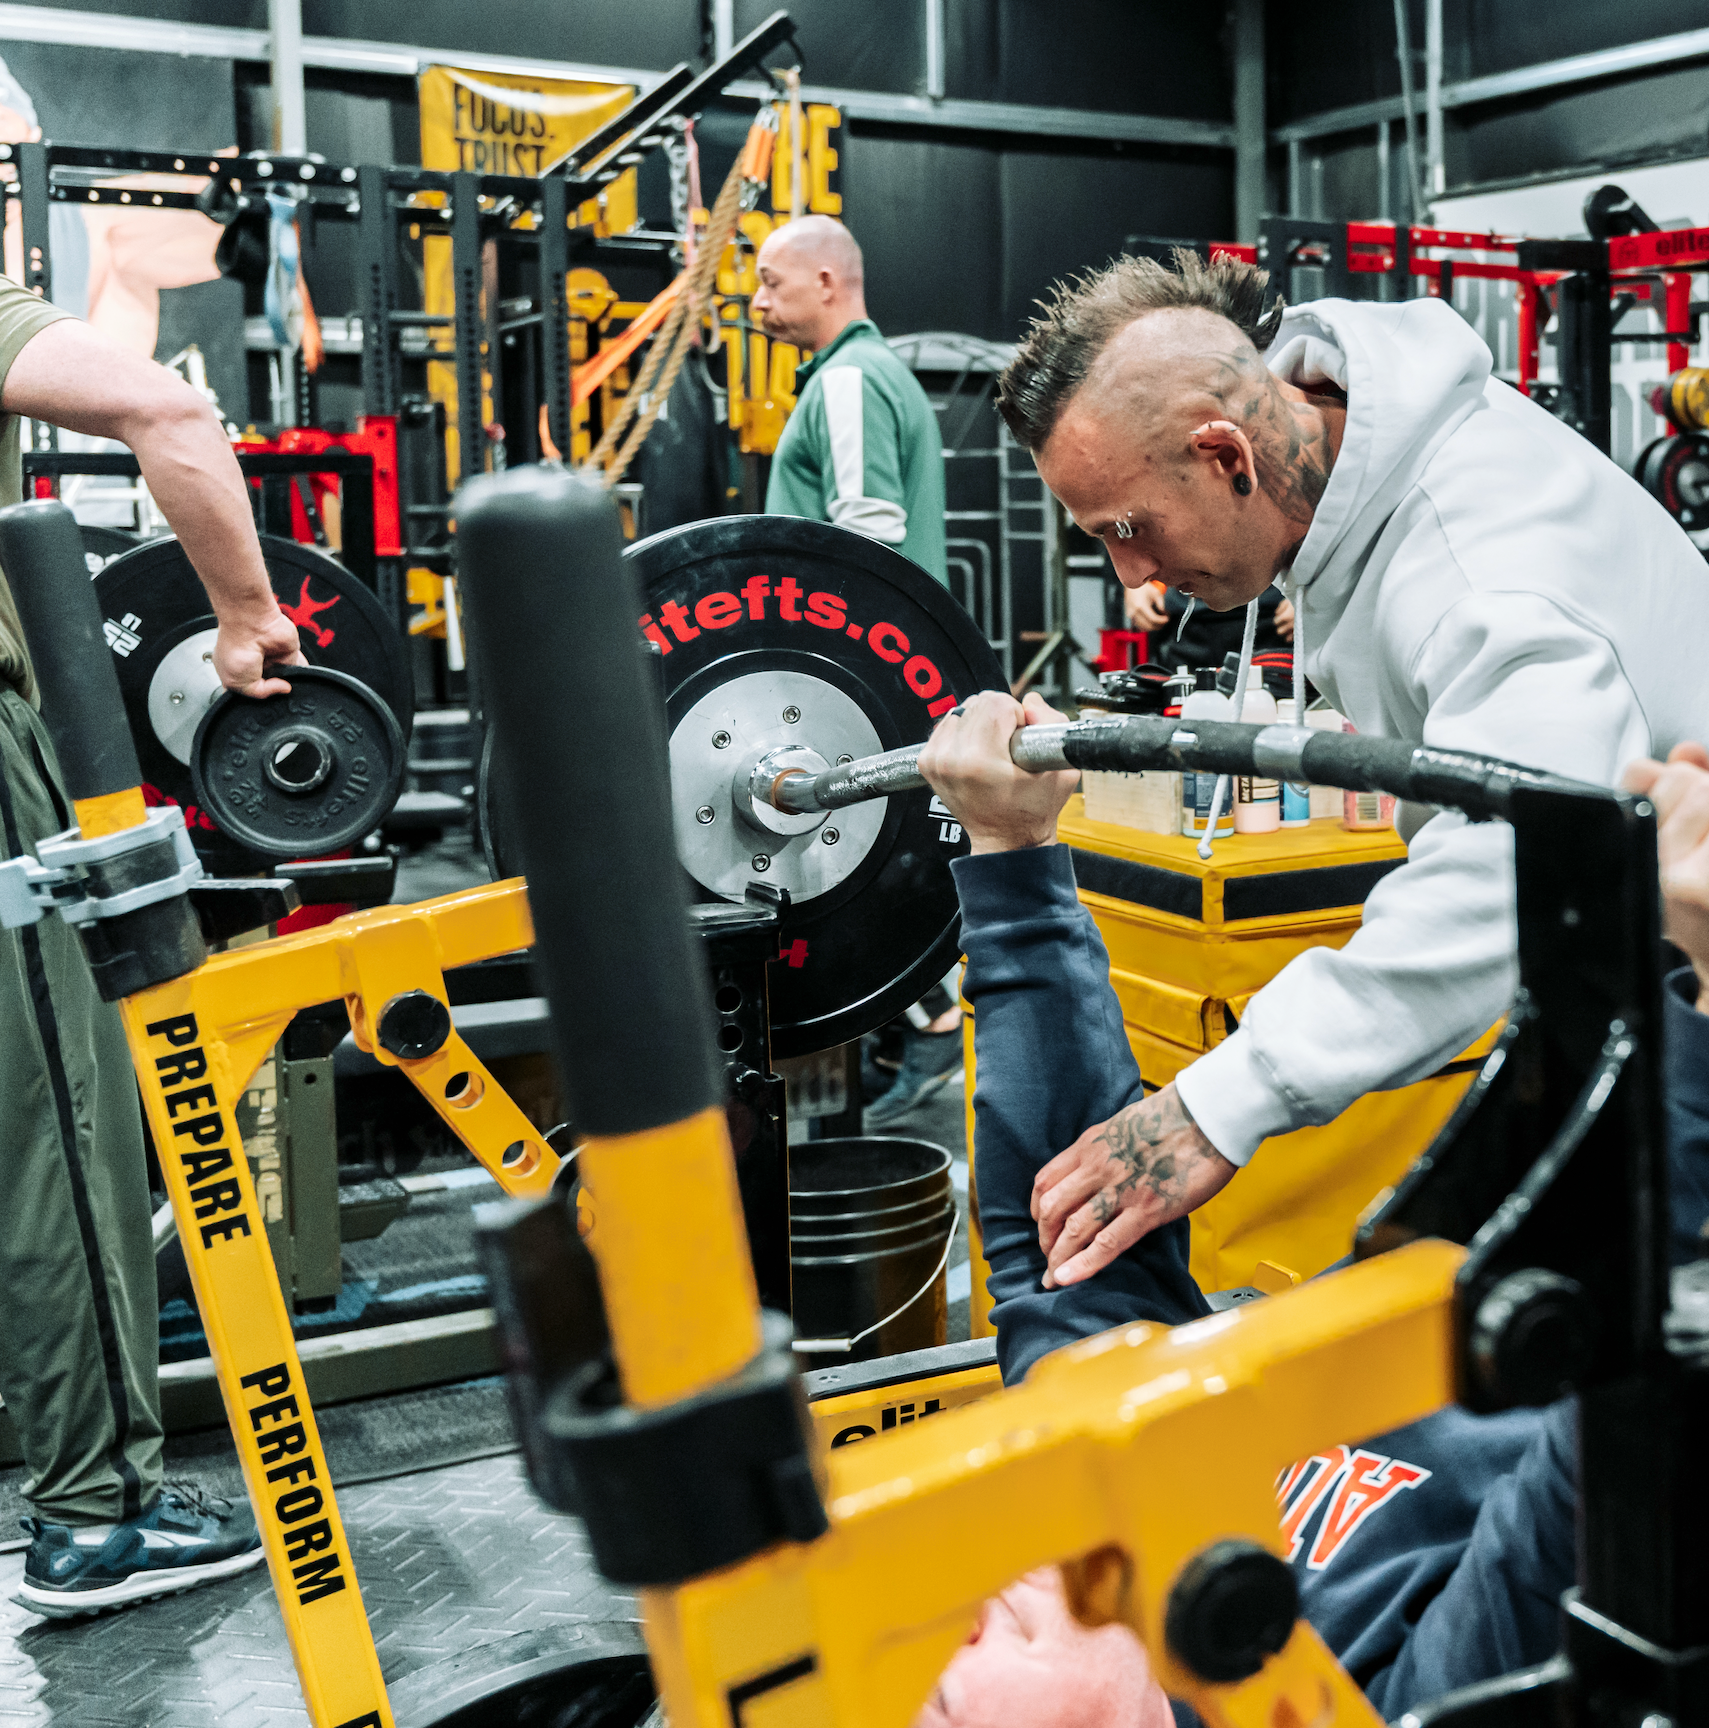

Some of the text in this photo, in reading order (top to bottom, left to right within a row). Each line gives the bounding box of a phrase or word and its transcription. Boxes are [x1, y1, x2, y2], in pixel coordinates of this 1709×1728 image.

[638, 575, 958, 718] itefts.co
[939, 821, 963, 844] LB
[146, 1012, 252, 1250] PREPARE
[240, 1361, 346, 1606] PERFORM
[1273, 1444, 1433, 1571] AU
